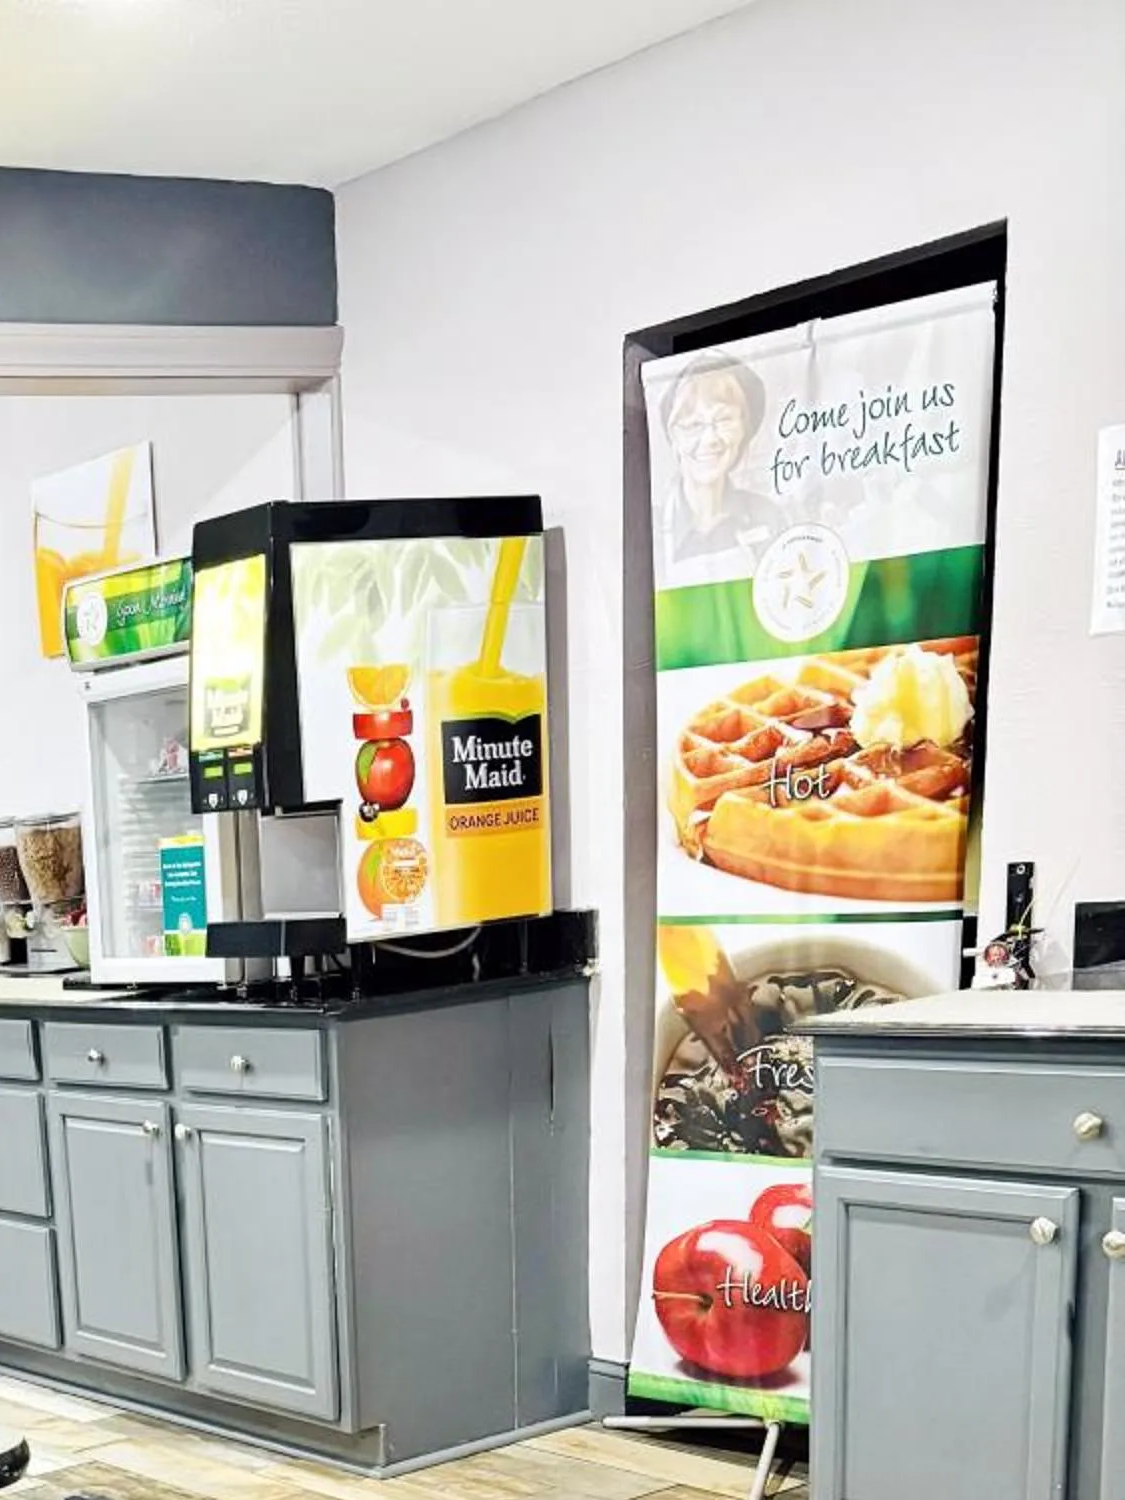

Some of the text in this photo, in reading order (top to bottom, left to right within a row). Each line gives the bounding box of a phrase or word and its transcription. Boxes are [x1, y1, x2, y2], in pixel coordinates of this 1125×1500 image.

[777, 383, 956, 439] Come join us
[770, 420, 960, 494] for breakfast
[450, 735, 533, 763] Minute
[464, 759, 524, 791] Maid
[763, 758, 831, 808] Hot
[450, 807, 540, 831] ORANGE JUICE
